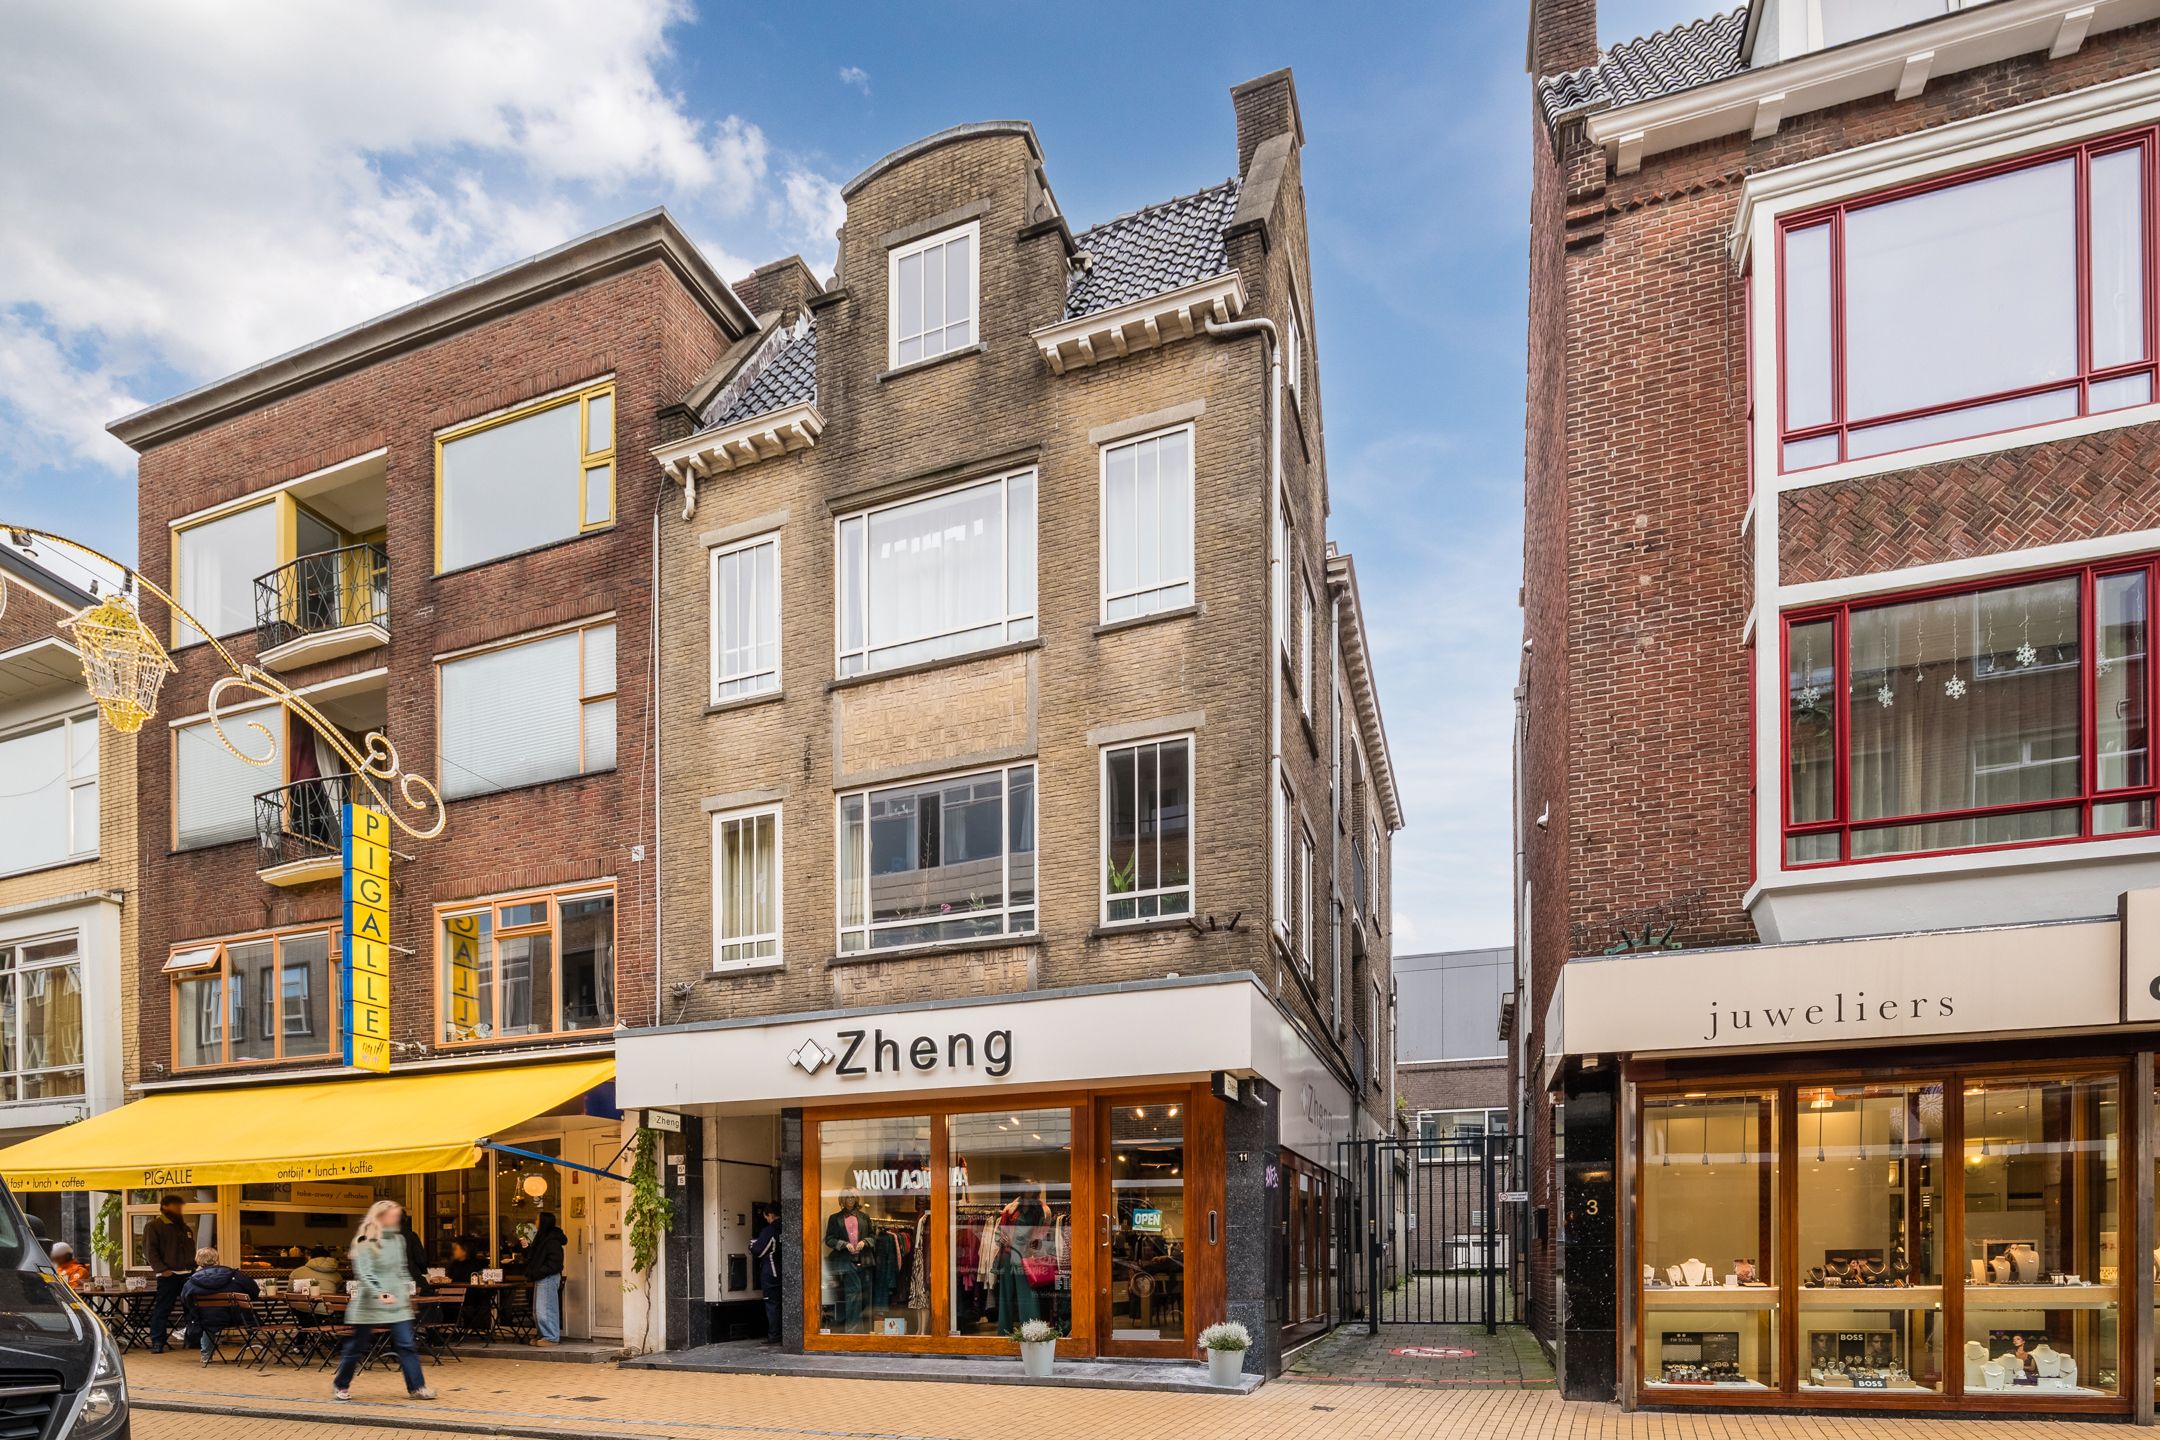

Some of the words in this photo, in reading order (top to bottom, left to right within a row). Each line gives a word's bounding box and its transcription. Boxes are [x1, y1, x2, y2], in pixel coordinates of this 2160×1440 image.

[360, 813, 382, 1034] PIGALLE
[1703, 991, 1954, 1041] juweliers
[836, 1029, 1012, 1077] Zheng
[655, 1115, 680, 1129] Zheng
[1239, 1153, 1248, 1162] 11
[143, 1169, 193, 1186] PIGALLE
[277, 1166, 304, 1180] ontbijt
[315, 1163, 338, 1177] lunch
[349, 1160, 374, 1174] koffie
[32, 1177, 52, 1189] lunch
[61, 1176, 85, 1188] coffee
[1586, 1199, 1599, 1216] 3
[1134, 1212, 1161, 1226] OPEN
[1840, 1333, 1864, 1341] BOSS
